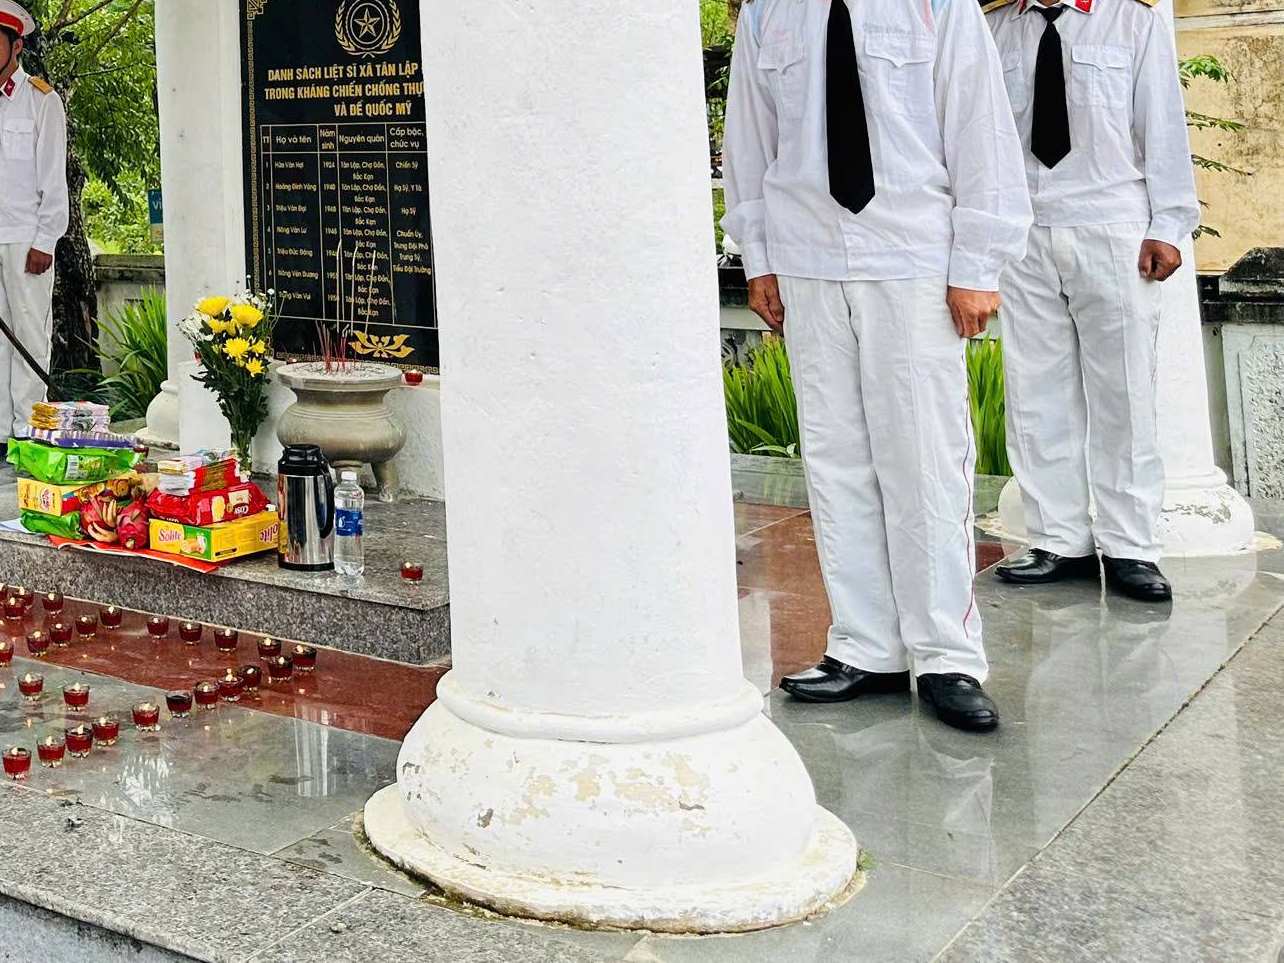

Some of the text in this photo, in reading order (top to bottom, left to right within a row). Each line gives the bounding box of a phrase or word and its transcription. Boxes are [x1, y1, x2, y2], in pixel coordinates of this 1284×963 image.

[268, 61, 419, 81] DANH SÁCH LIỆT SĨ XÃ TÂN LẬP
[264, 79, 425, 100] TRONG KHÁNG CHIẾN CHỐNG THỰ
[334, 101, 348, 117] VÀ
[366, 99, 393, 117] QUỐC
[396, 100, 412, 115] MỸ
[390, 127, 405, 137] Cấp
[276, 135, 312, 145] Họ và tên
[339, 134, 365, 145] Nguyên
[390, 140, 420, 150] chức vụ
[322, 142, 335, 150] sinh
[159, 529, 182, 542] Solite
